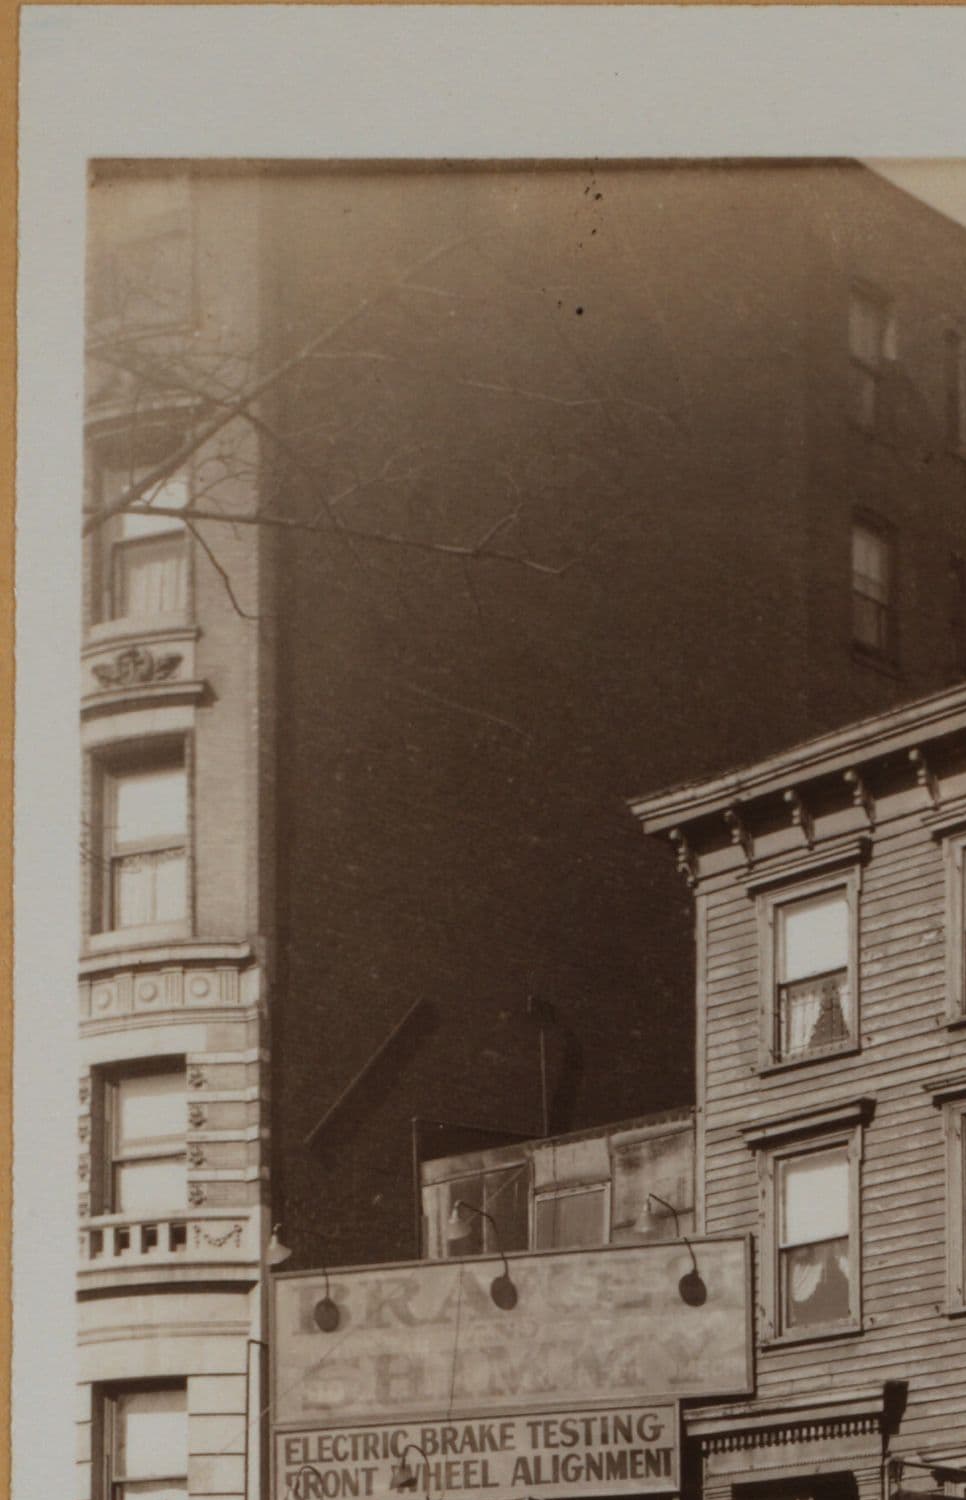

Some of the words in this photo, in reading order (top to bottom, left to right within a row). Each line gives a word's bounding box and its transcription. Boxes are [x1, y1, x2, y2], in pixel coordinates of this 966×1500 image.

[285, 1430, 406, 1466] ELECTRIC
[420, 1422, 516, 1456] BRAKE
[526, 1413, 665, 1450] TESTING
[389, 1458, 500, 1492] WHEEL
[511, 1447, 674, 1488] ALIGNMENT
